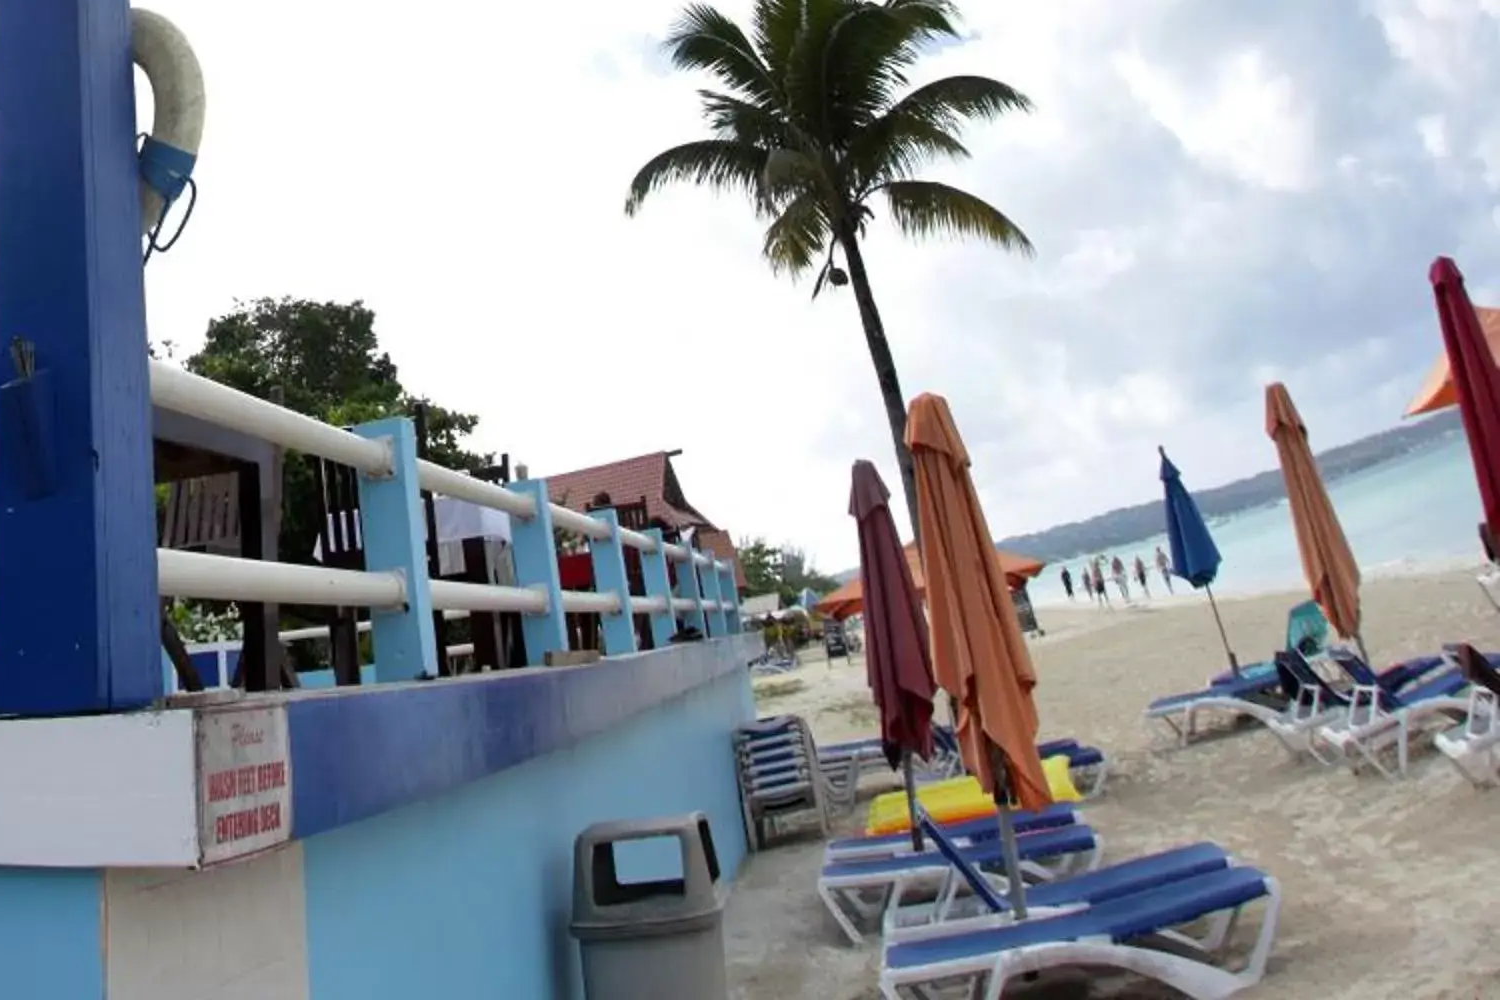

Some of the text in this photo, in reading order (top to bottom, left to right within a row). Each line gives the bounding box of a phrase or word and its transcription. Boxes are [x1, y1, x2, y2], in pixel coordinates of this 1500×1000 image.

[231, 723, 264, 747] Please
[208, 760, 285, 803] WASH FEET BEFORE
[215, 806, 259, 845] ENTERING
